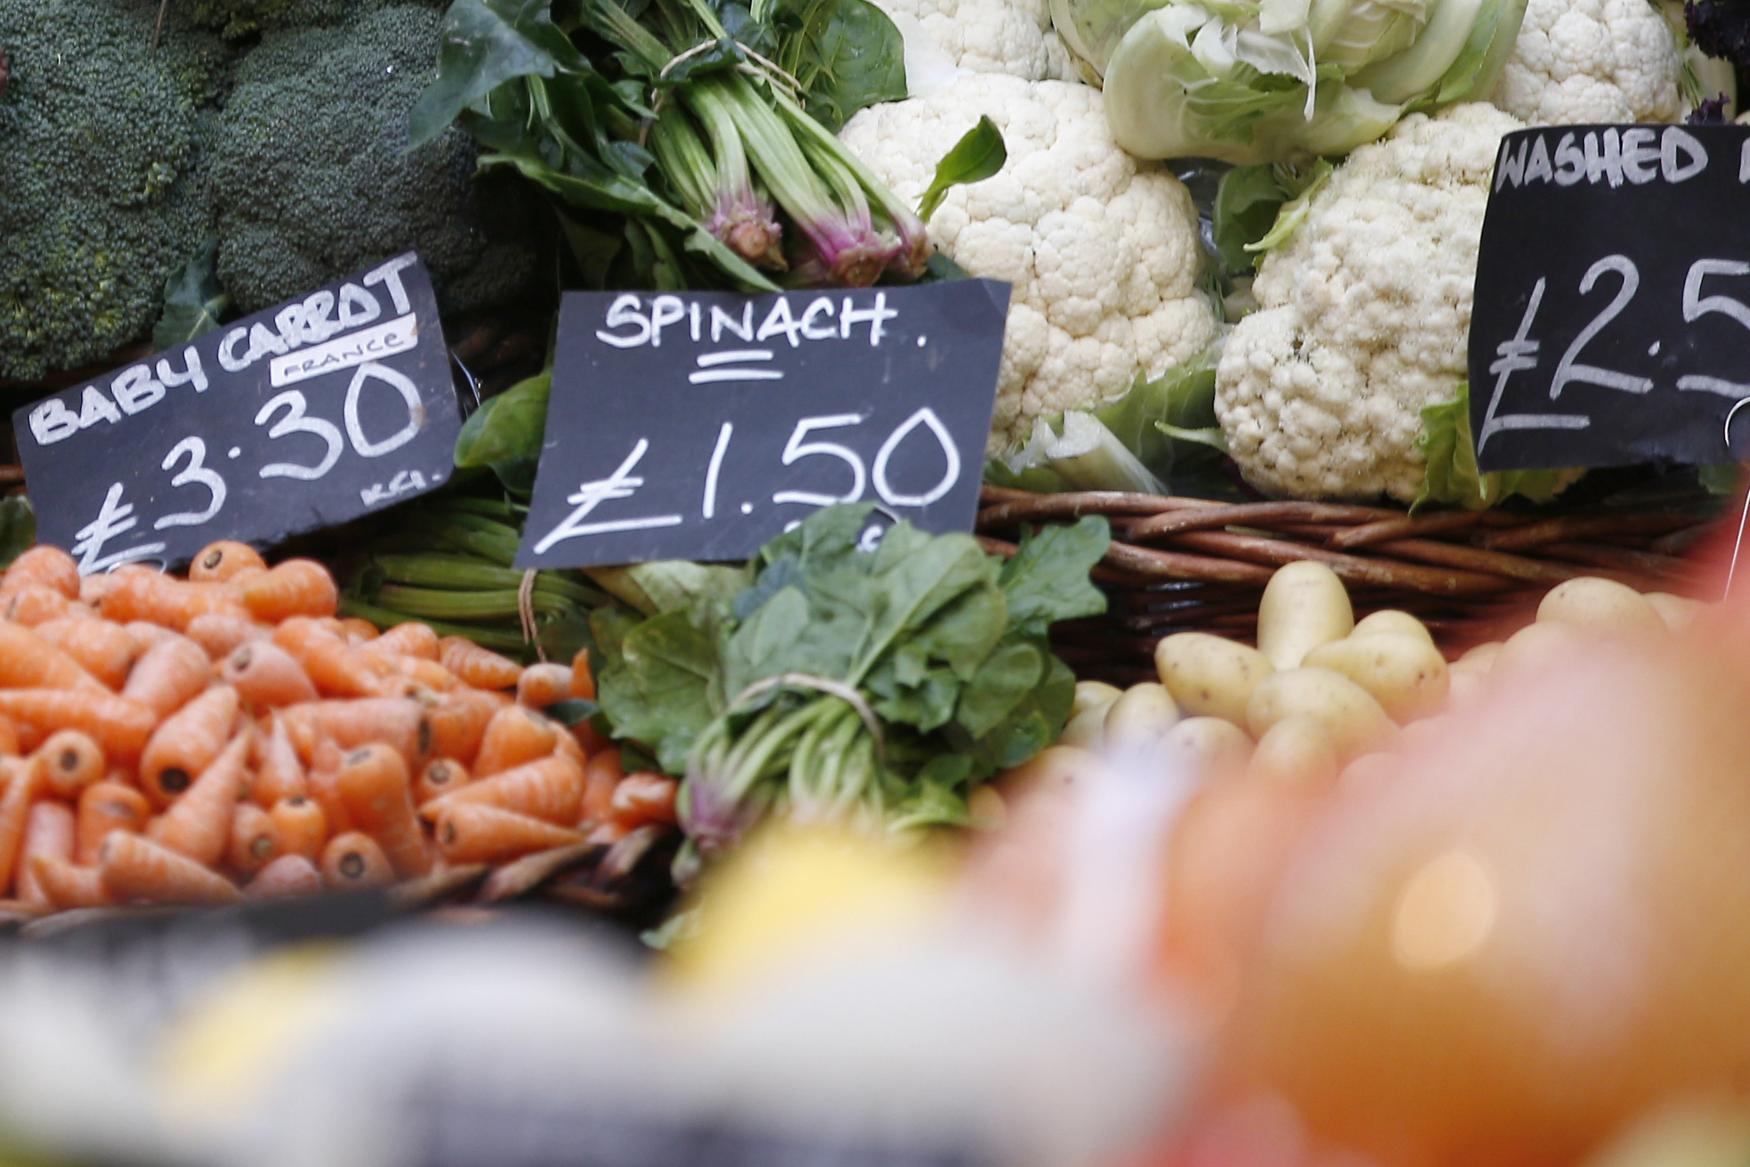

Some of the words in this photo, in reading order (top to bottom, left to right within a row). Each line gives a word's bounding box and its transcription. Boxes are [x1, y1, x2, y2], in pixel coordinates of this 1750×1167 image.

[1495, 125, 1709, 194] WASHED
[28, 344, 210, 446] BABY
[217, 250, 419, 373] CARROT
[596, 291, 929, 348] SPINACH.
[71, 361, 424, 577] £3.30
[534, 407, 961, 555] £1.50
